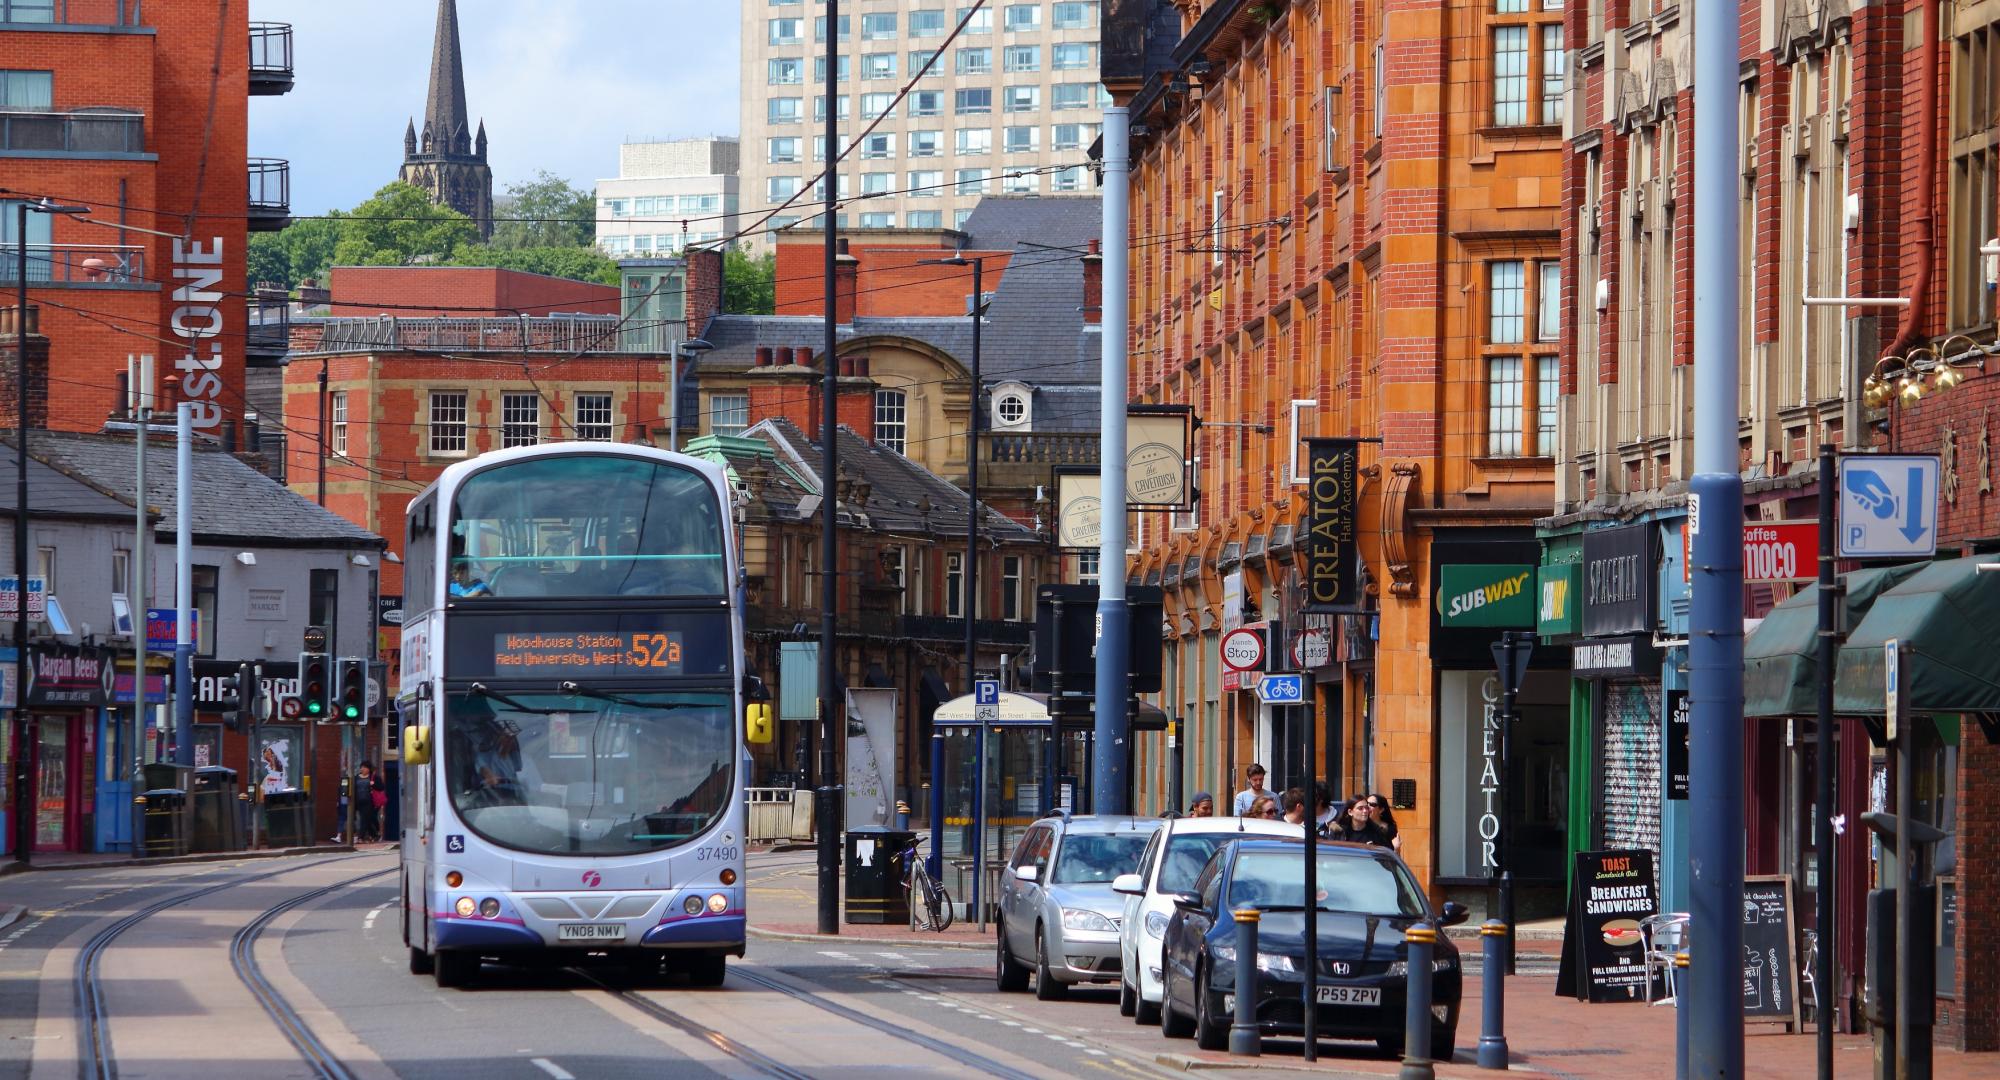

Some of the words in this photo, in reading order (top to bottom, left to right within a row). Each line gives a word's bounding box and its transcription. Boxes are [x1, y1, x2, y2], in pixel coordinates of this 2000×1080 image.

[1145, 463, 1157, 476] the
[1134, 473, 1177, 493] CAVENDISH
[1341, 451, 1354, 511] Academy
[1071, 522, 1101, 538] CAVENDIS
[1312, 453, 1339, 602] CREATOR
[1341, 520, 1351, 542] Hair
[1850, 527, 1863, 546] P
[1448, 571, 1530, 618] SUBWAY
[1540, 577, 1568, 623] SUBWAY
[507, 635, 573, 649] Woodhouse
[576, 635, 623, 649] Station
[632, 634, 681, 667] 52a
[1227, 647, 1258, 660] Stop
[593, 652, 623, 666] West
[40, 653, 72, 684] Bargain
[74, 656, 98, 678] Beers
[981, 683, 995, 703] P
[697, 847, 738, 861] 37490
[1602, 857, 1630, 871] TOAST
[1596, 871, 1625, 879] Sandwich
[1590, 885, 1648, 900] BREAKFAST
[1586, 899, 1653, 914] SANDWICHES
[564, 926, 594, 937] YN08
[597, 926, 620, 937] NMV
[1352, 989, 1378, 1003] ZPV
